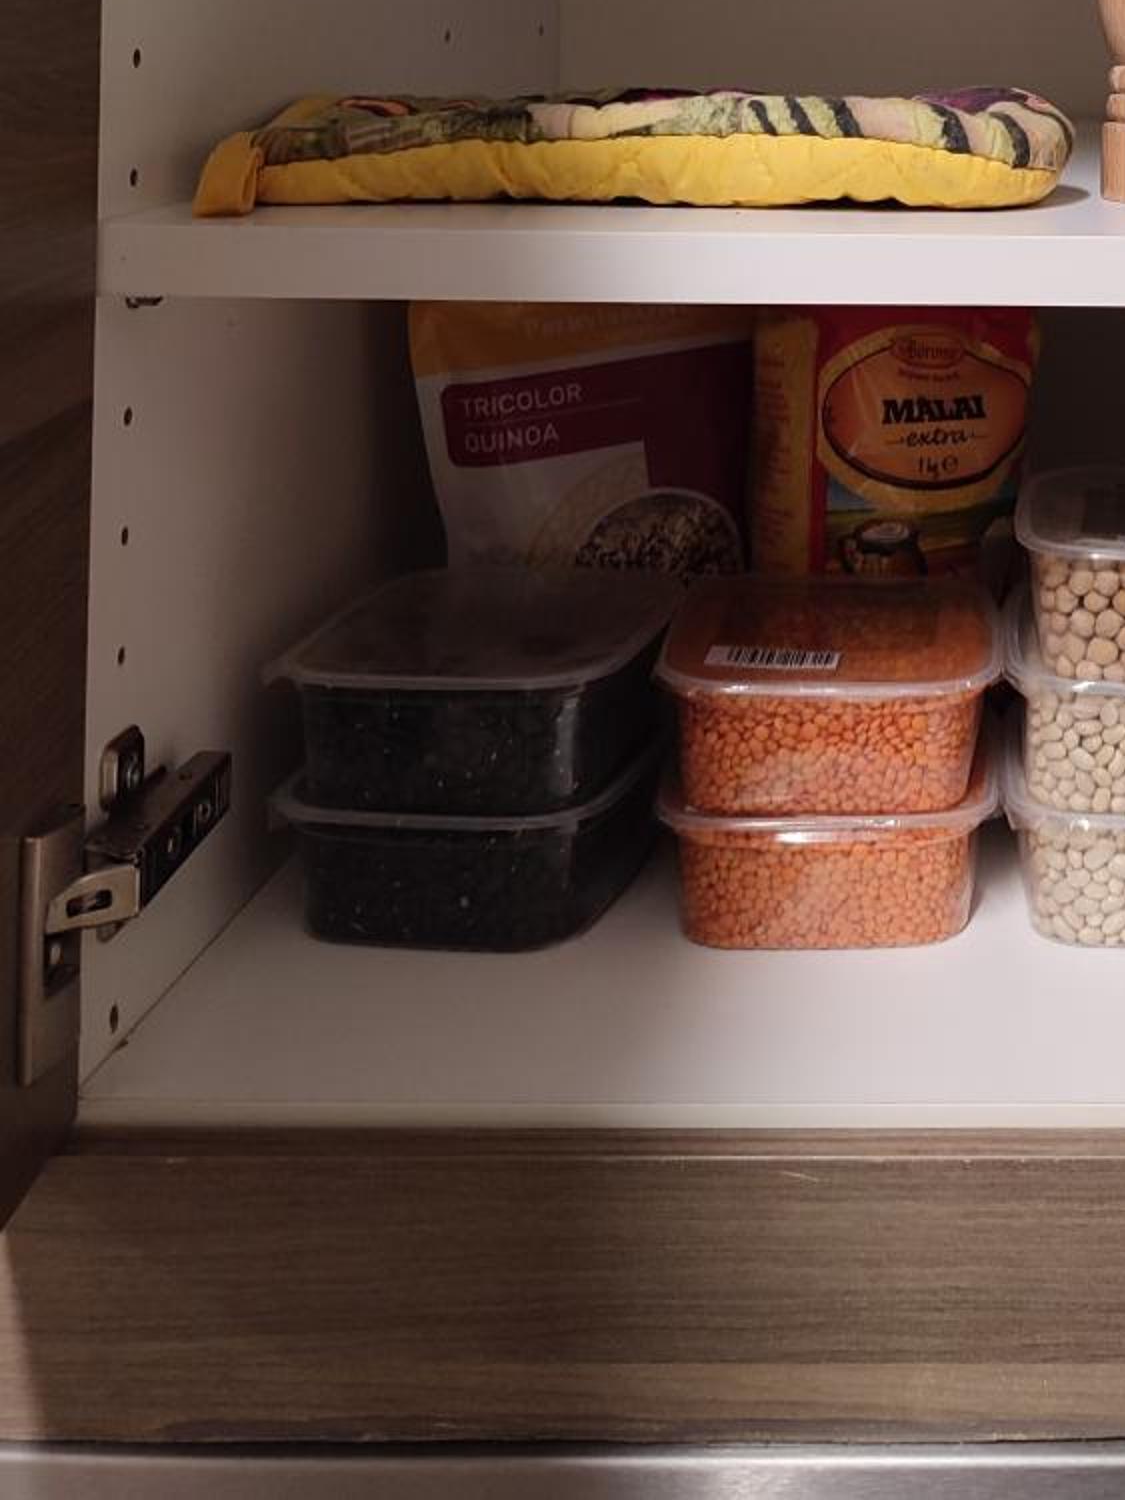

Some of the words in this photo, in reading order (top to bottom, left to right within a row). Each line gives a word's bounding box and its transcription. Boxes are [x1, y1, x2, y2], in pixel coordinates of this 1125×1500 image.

[462, 383, 584, 419] TRICOLOR
[463, 422, 561, 453] QUINOA
[906, 427, 968, 448] extra
